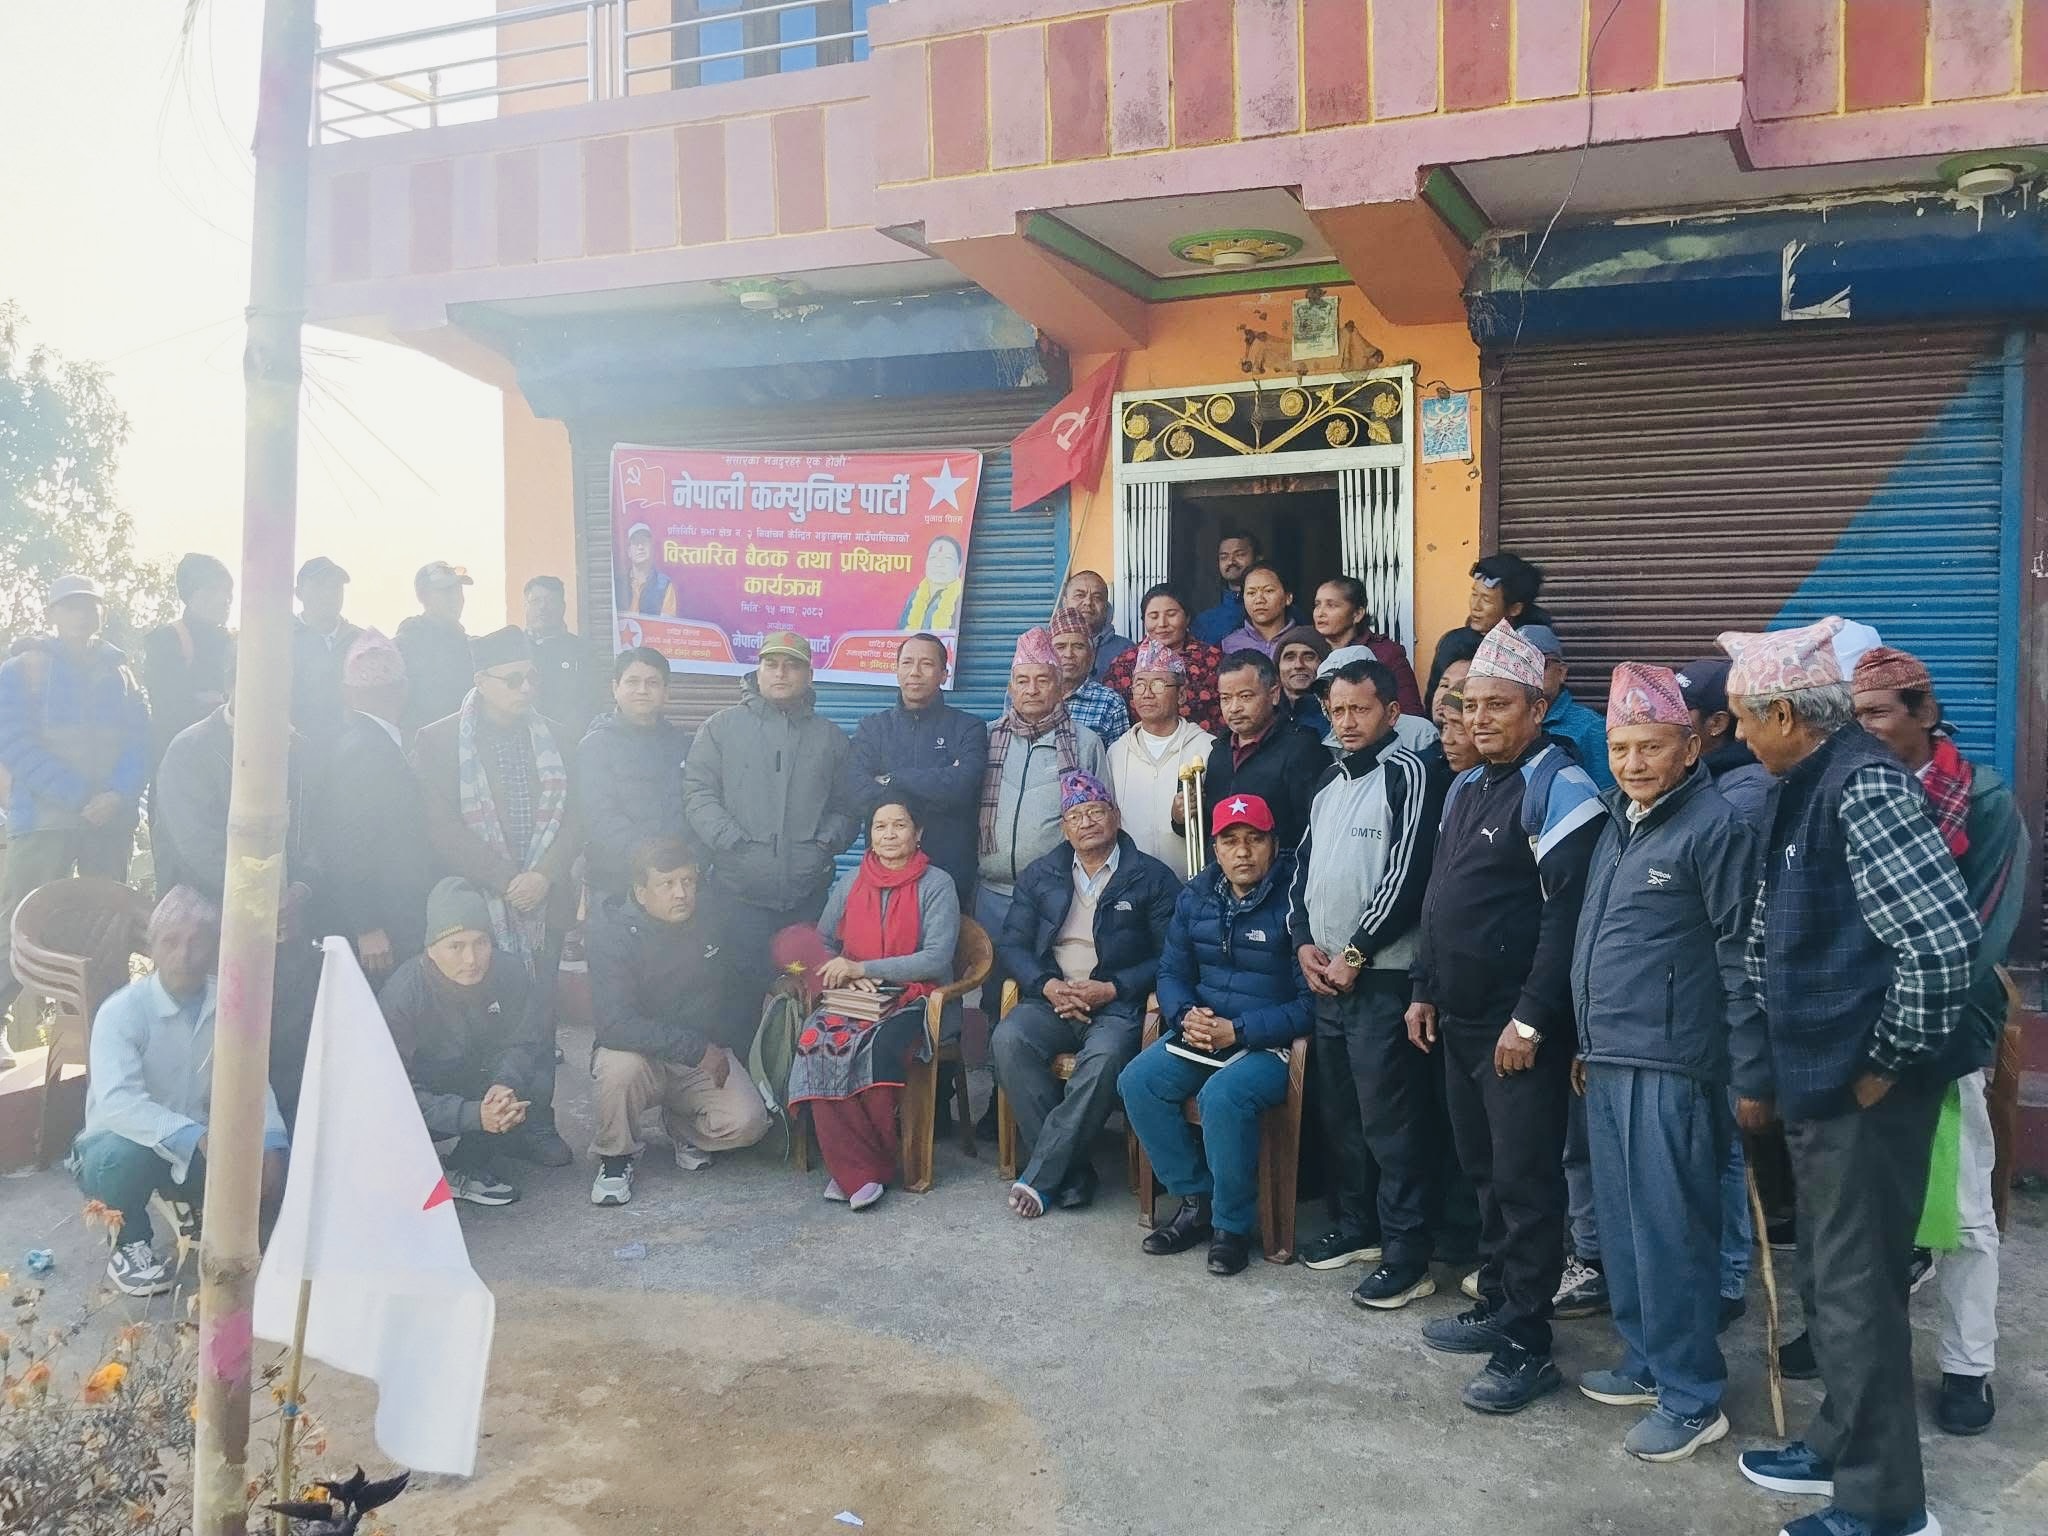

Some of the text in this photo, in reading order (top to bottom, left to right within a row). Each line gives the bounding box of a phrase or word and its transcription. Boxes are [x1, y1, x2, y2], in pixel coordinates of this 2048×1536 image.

[806, 456, 821, 468] एक
[671, 470, 910, 523] नेपाली कम्युनिष्ट पार्टी
[924, 514, 942, 525] चुनाव
[667, 525, 697, 537] प्रतिनिधि
[700, 527, 715, 537] सभा
[718, 527, 732, 537] क्षेत्र
[747, 529, 753, 540] २
[663, 540, 912, 573] विस्तारित बैठक तथा प्रशिक्षण
[744, 574, 823, 597] कार्यक्रम
[802, 606, 824, 618] २०८२
[731, 630, 764, 649] नेपाली
[809, 635, 832, 654] पार्टी
